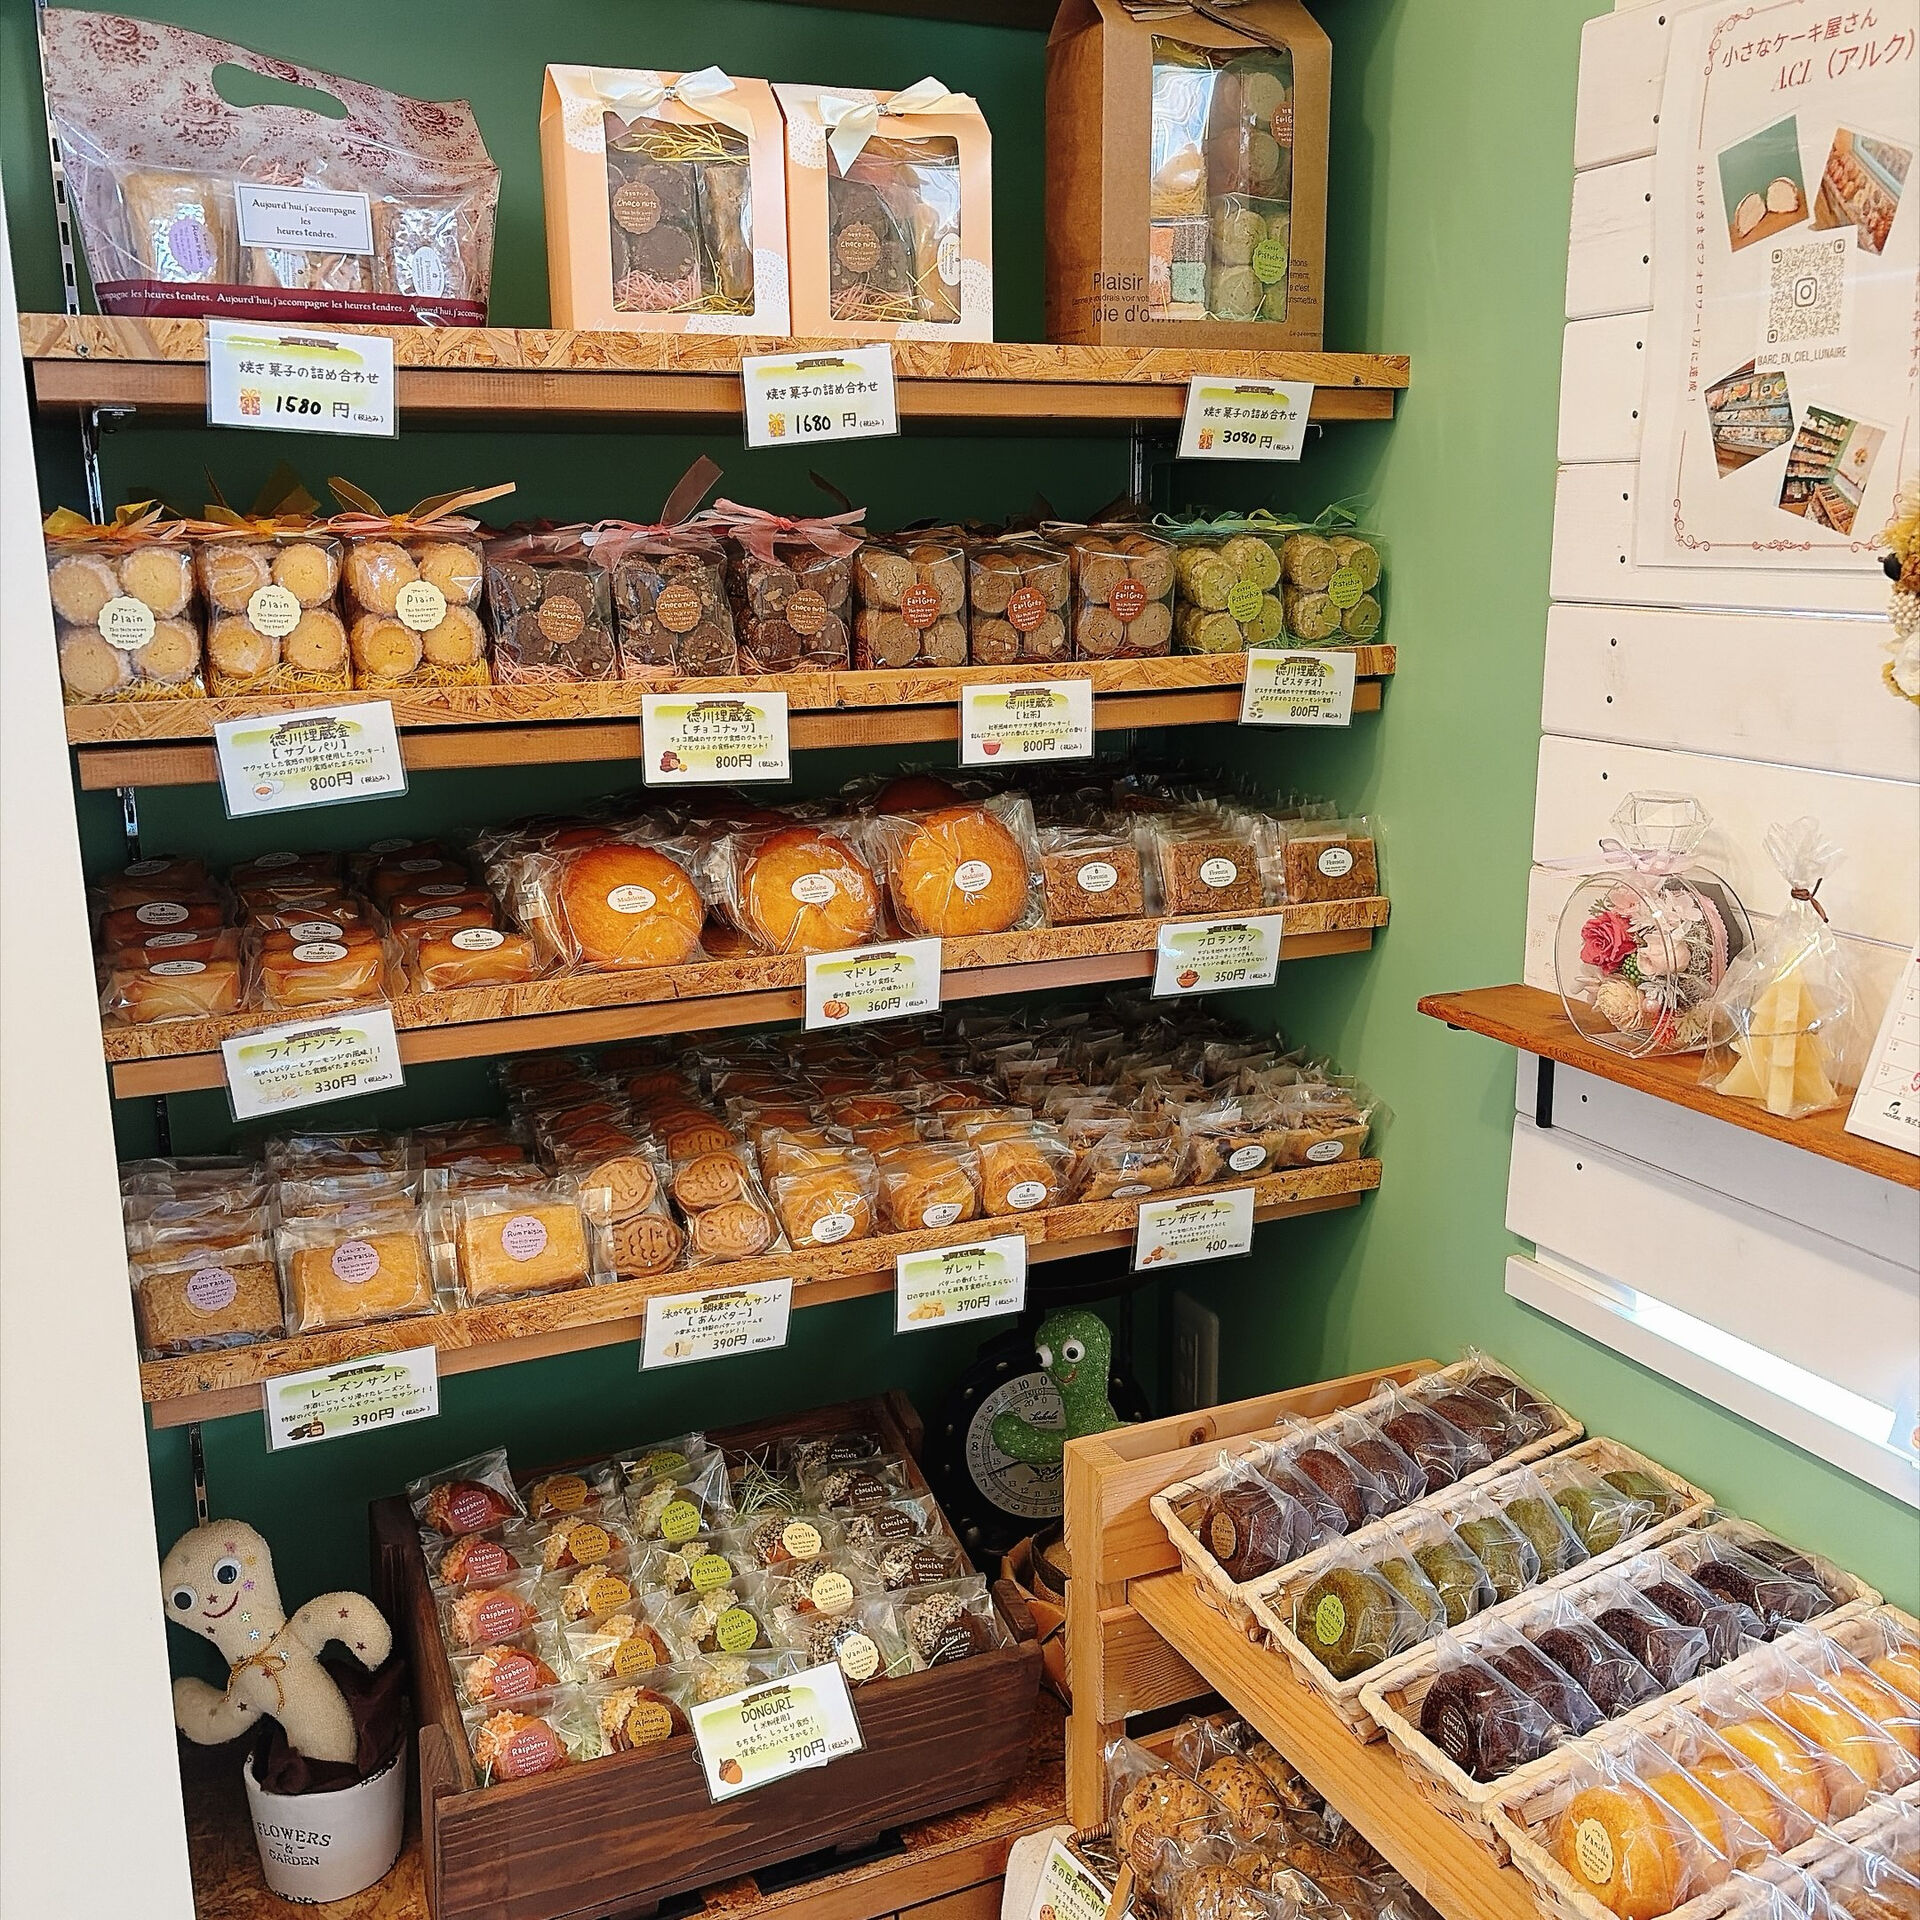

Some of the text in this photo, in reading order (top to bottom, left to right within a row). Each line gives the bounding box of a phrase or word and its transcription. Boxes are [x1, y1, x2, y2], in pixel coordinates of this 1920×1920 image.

[1723, 7, 1878, 68] 小さなケーキ屋さん
[1828, 28, 1916, 79] （アルク）
[617, 199, 657, 209] Choco nuts
[301, 217, 312, 226] les
[276, 227, 337, 239] heures tendres.
[1092, 273, 1144, 292] Plaisir
[131, 290, 142, 299] les
[144, 289, 175, 300] heures
[176, 290, 213, 302] tendres.
[331, 300, 343, 309] les
[344, 301, 371, 311] heures
[372, 302, 405, 312] tendres.
[1092, 306, 1118, 328] joie
[239, 361, 380, 385] 焼き菓子の詰め合わせ
[766, 380, 879, 401] 焼き菓子の詰め合わせ
[276, 395, 322, 415] 1580
[333, 402, 350, 419] 円
[1204, 406, 1298, 421] 焼き菓子の詰め合わせ
[795, 415, 831, 433] 1680
[842, 412, 857, 428] 円
[1223, 430, 1257, 444] 3080
[1259, 436, 1273, 449] 円
[259, 599, 289, 609] Plain
[407, 594, 435, 605] Plain
[112, 613, 143, 624] Plain
[687, 709, 756, 724] 徳川埋蔵金
[1290, 705, 1319, 717] 800円
[270, 724, 350, 747] 徳川埋蔵金
[1023, 738, 1055, 752] 800円
[716, 754, 752, 768] 800円
[310, 771, 353, 791] 800円
[1198, 933, 1256, 947] フロランタン
[843, 962, 902, 979] マドレーヌ
[1214, 969, 1246, 982] 350円
[867, 997, 901, 1012] 360円
[266, 1036, 356, 1059] フィナンシェ
[315, 1074, 357, 1094] 330円
[1156, 1209, 1231, 1228] エンガディナー
[1205, 1239, 1227, 1253] 400
[944, 1260, 985, 1275] ガレット
[662, 1293, 783, 1320] 泳がない鯛焼きくんサンド
[957, 1295, 990, 1311] 370円
[712, 1333, 748, 1350] 390円
[312, 1370, 407, 1398] レーズンサンド
[1018, 1380, 1030, 1391] 10
[1040, 1376, 1047, 1386] 0
[352, 1407, 394, 1427] 390円
[972, 1442, 979, 1450] 8
[854, 1485, 883, 1496] Chocolate
[454, 1499, 486, 1515] Raspberry
[787, 1532, 815, 1540] Vanilla
[468, 1552, 502, 1563] Raspberry
[817, 1583, 846, 1596] Vanilla
[480, 1607, 515, 1622] Raspberry
[845, 1646, 872, 1659] Vanilla
[495, 1665, 530, 1683] Raspberry
[741, 1696, 795, 1724] DONGURI
[511, 1740, 549, 1756] Raspberry
[788, 1738, 826, 1764] 370円
[256, 1822, 332, 1847] FLOWERS
[269, 1849, 320, 1866] GARDEN
